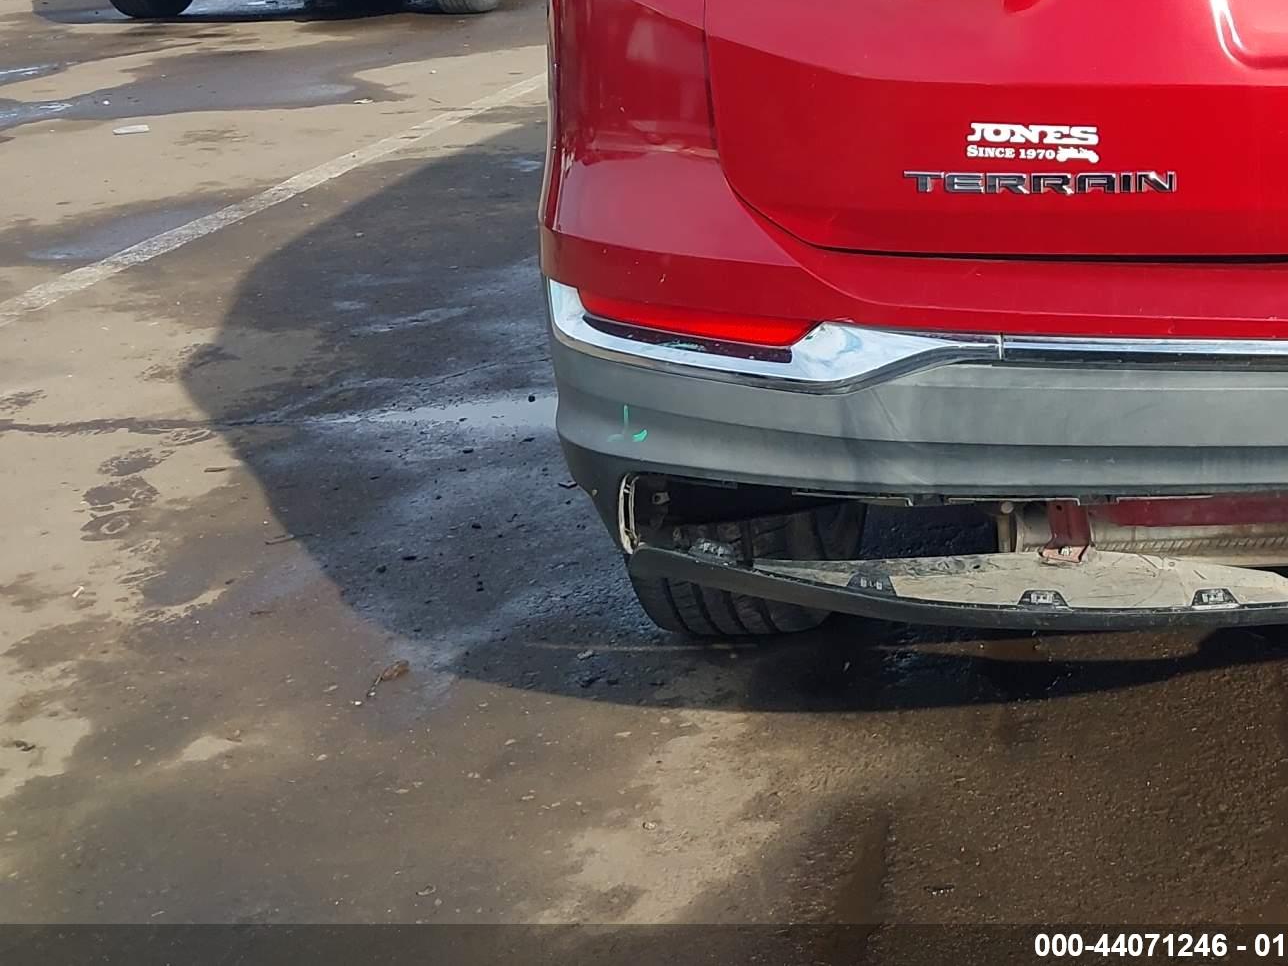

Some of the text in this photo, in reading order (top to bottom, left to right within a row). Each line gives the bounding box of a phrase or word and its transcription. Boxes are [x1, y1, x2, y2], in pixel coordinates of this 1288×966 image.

[967, 123, 1099, 145] JONES
[966, 146, 1056, 159] SINCE 1970
[904, 170, 1178, 194] TERRAIN
